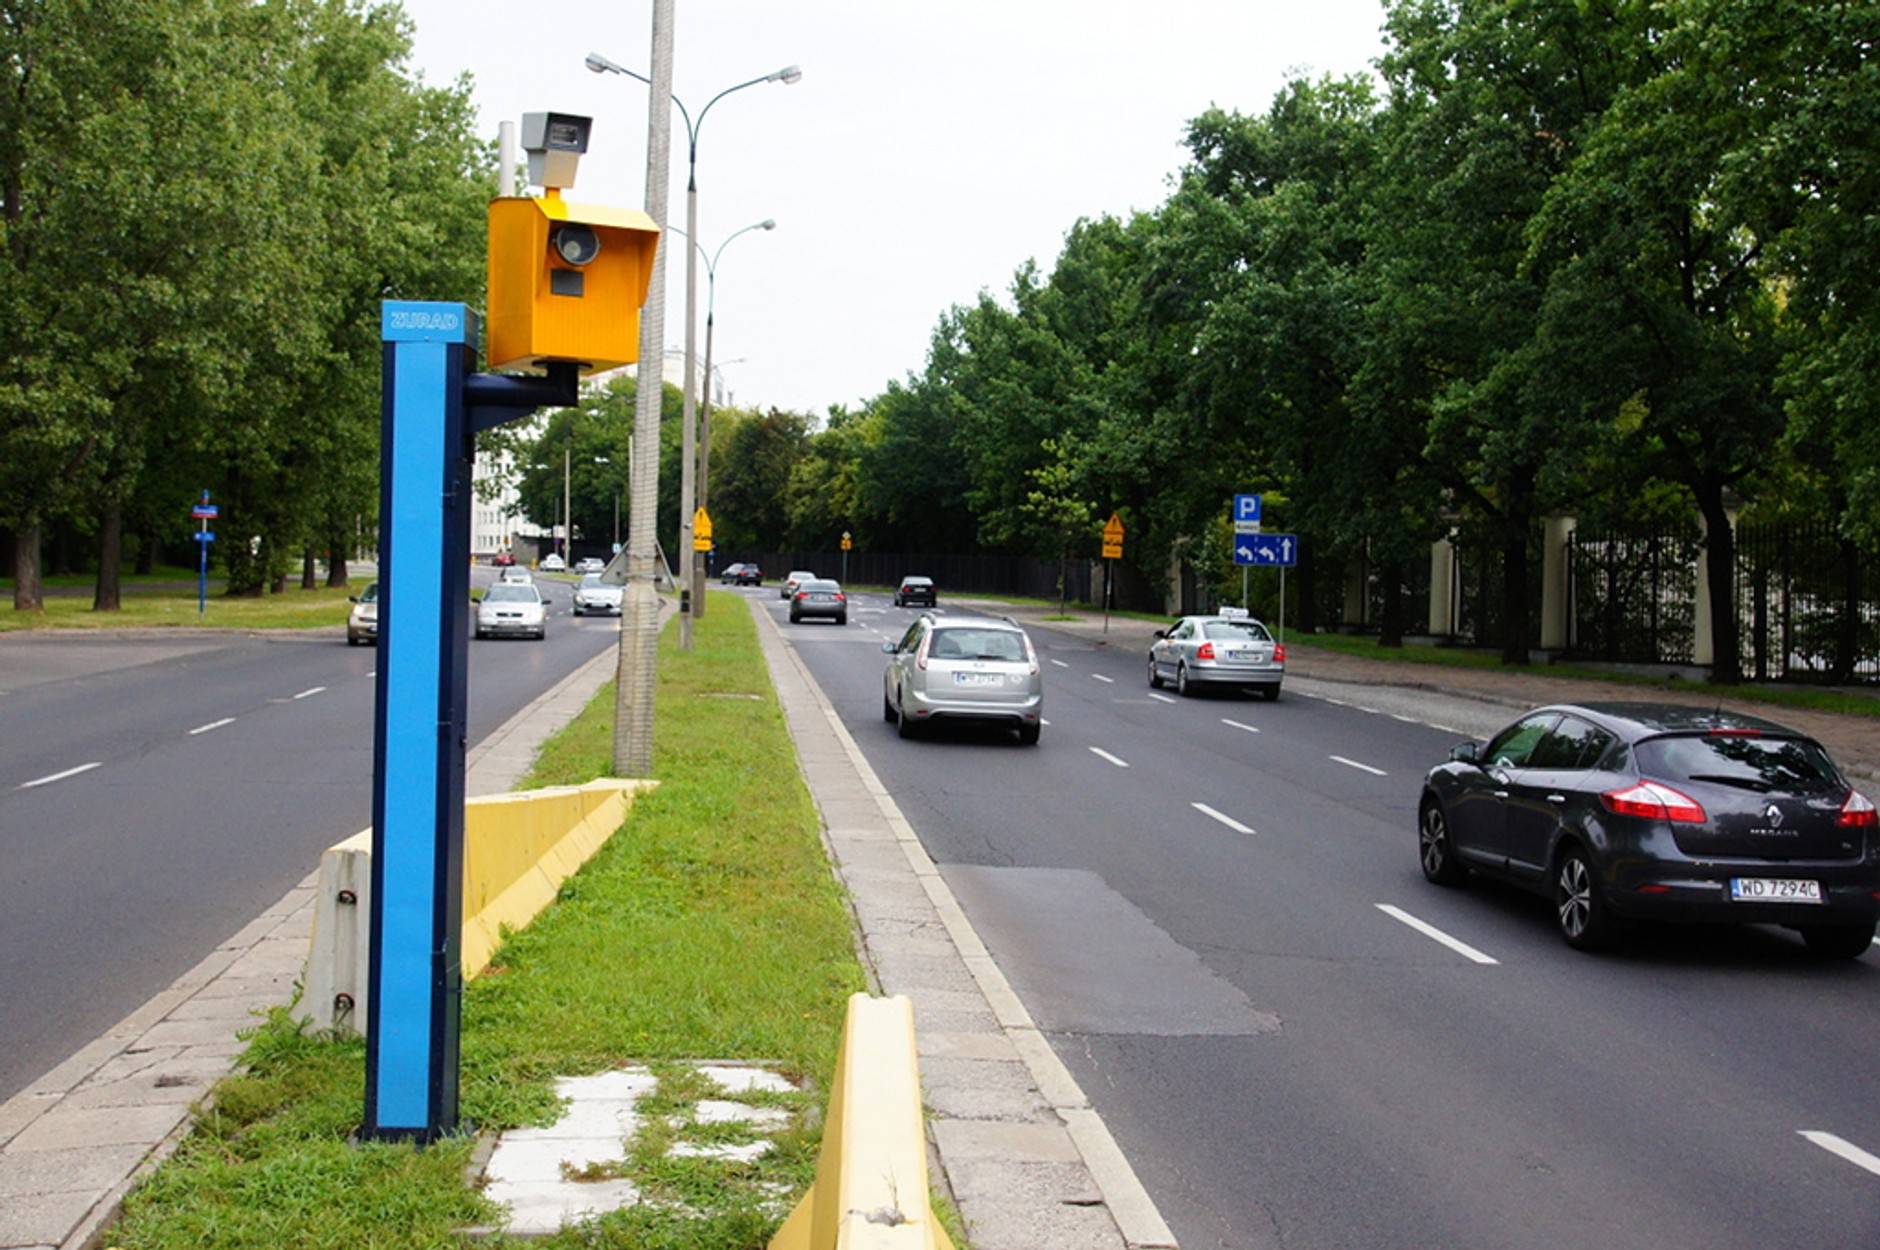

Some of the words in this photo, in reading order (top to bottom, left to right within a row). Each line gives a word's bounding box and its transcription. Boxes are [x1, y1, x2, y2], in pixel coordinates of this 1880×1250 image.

[391, 312, 458, 329] ZURAD
[1240, 497, 1256, 518] P
[1740, 881, 1764, 896] WD
[1769, 881, 1817, 897] 7294C
